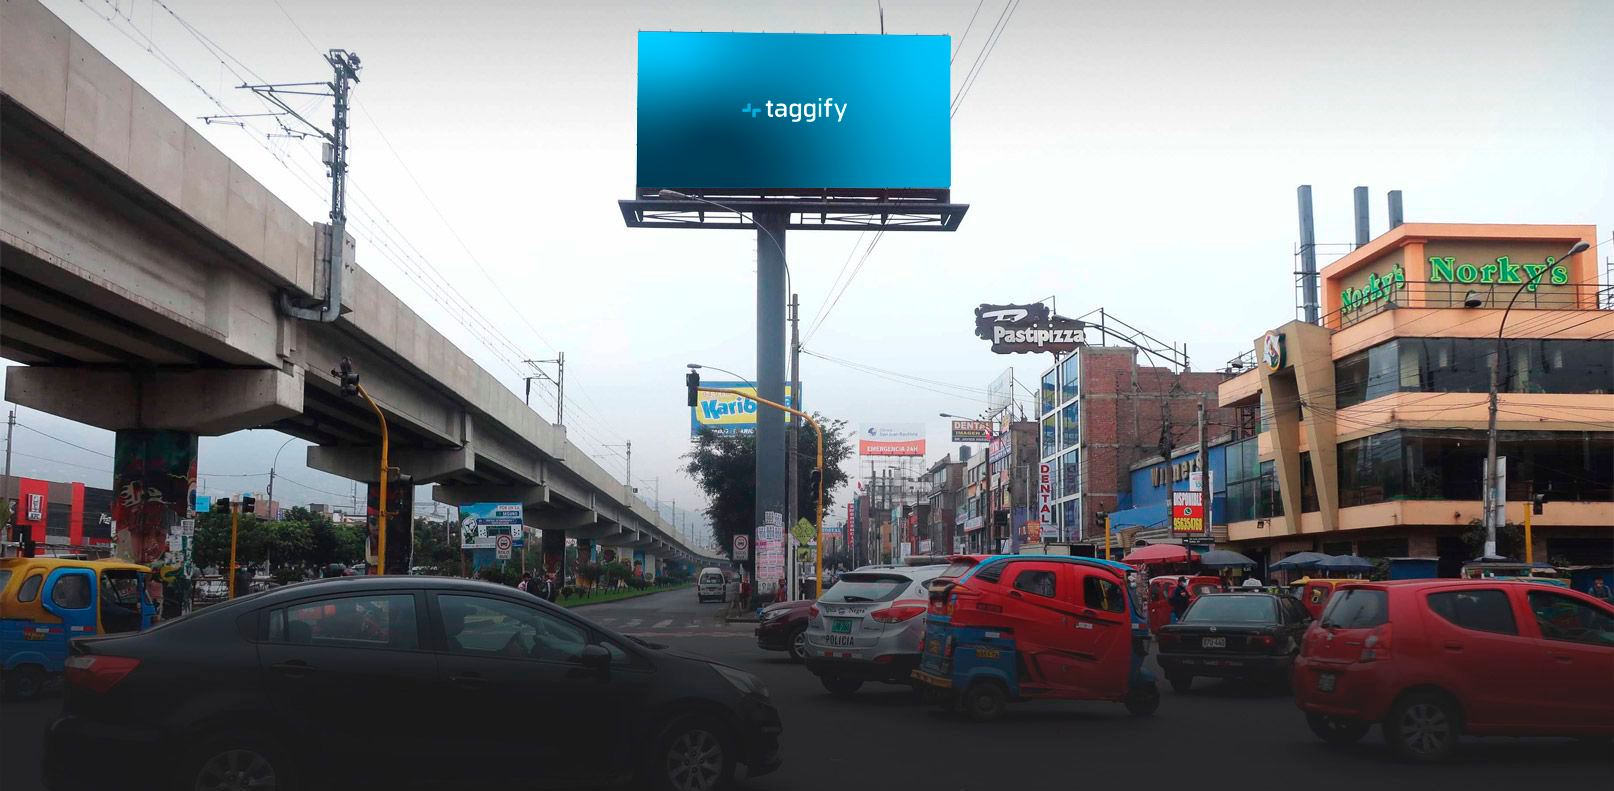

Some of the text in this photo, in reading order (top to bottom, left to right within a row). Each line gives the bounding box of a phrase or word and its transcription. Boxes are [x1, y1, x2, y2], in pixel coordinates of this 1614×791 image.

[765, 97, 848, 122] taggify
[1341, 264, 1405, 315] Norky's
[1430, 256, 1568, 292] Norky's
[994, 321, 1085, 347] Pastipizza
[1041, 465, 1050, 522] DENTAL
[825, 635, 854, 645] POLICIA
